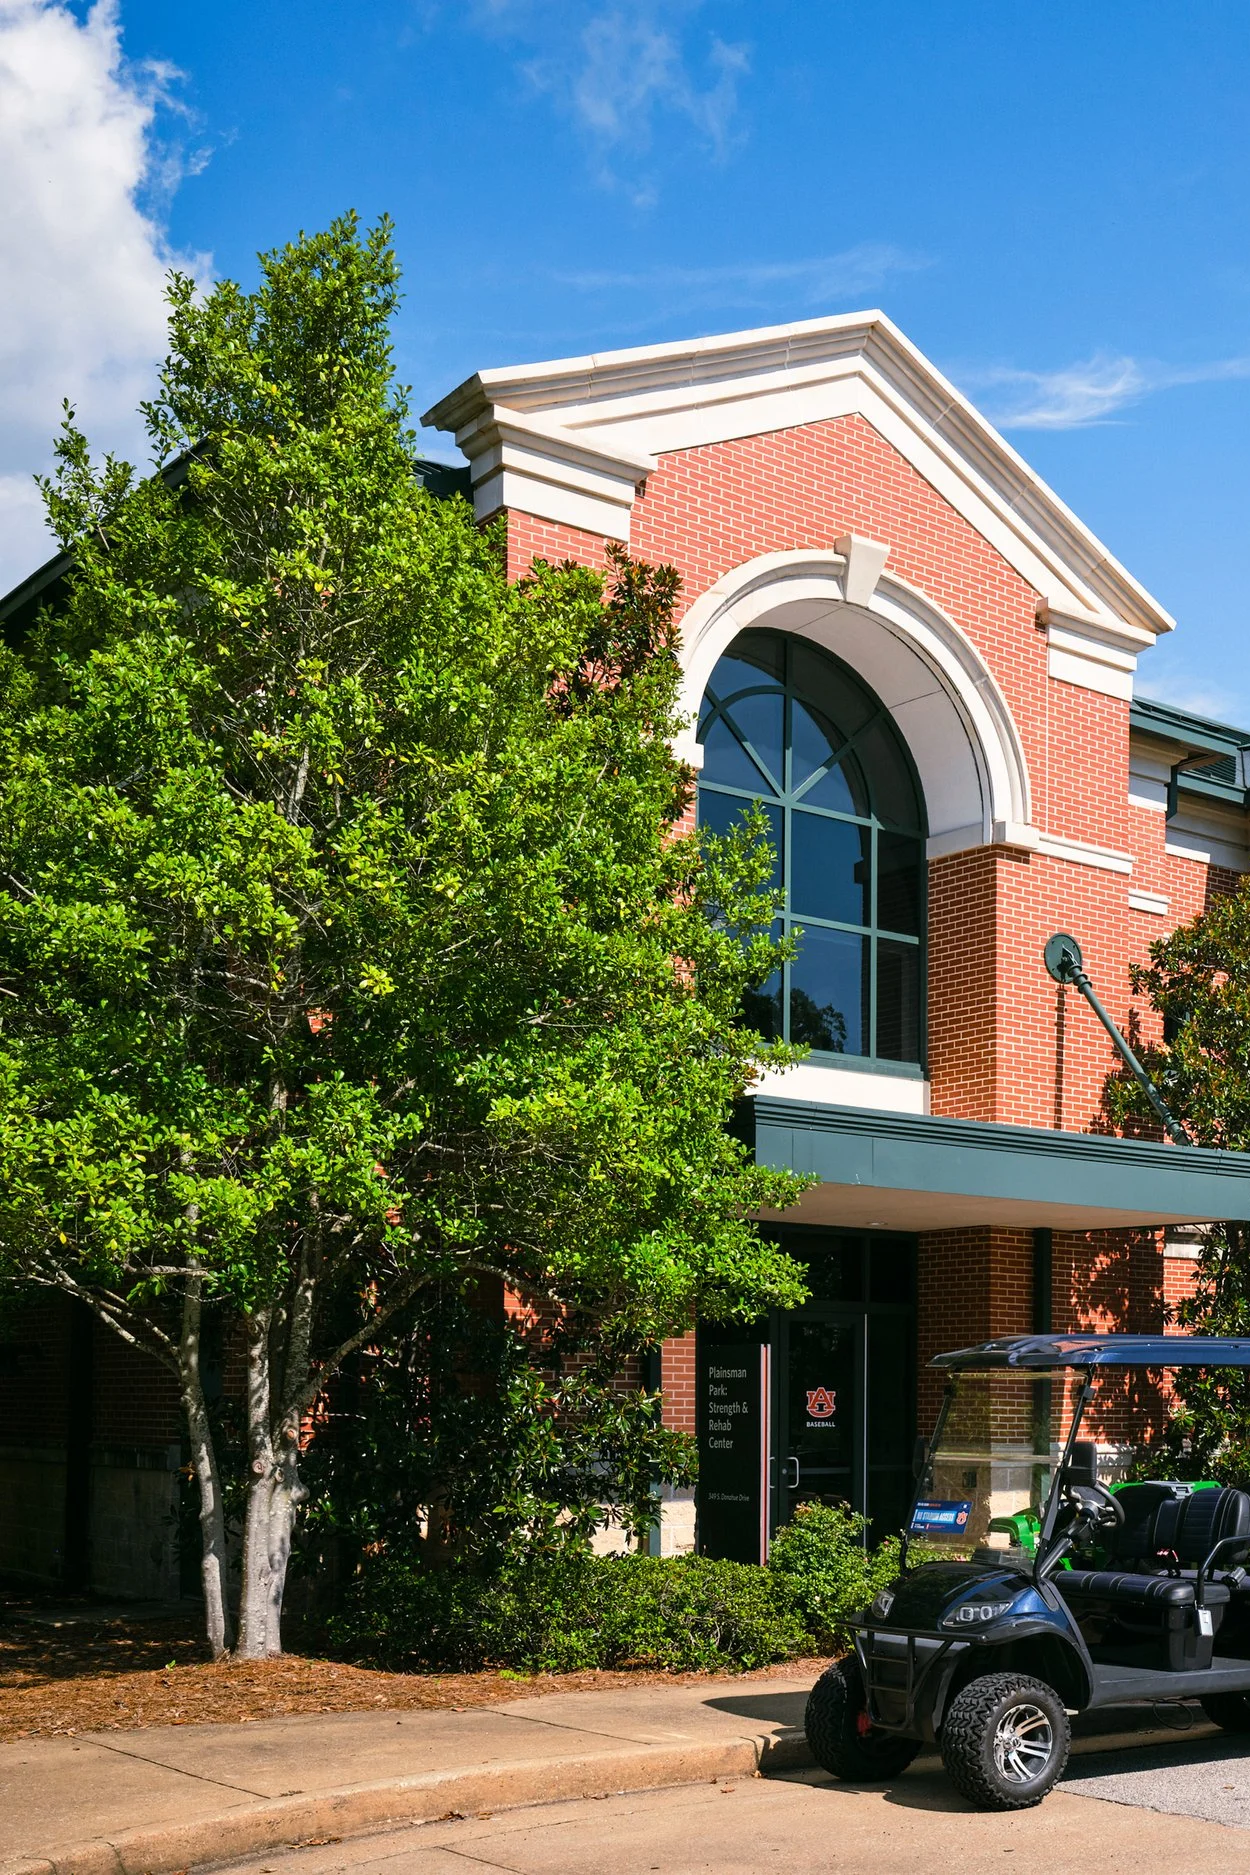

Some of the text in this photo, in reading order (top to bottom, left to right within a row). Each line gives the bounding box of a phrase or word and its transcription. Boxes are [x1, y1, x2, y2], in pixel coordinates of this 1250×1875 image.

[708, 1366, 747, 1378] Plainsman
[708, 1384, 728, 1396] Park:
[708, 1402, 749, 1415] Strength &
[708, 1419, 732, 1431] Rehab
[708, 1437, 734, 1449] Center
